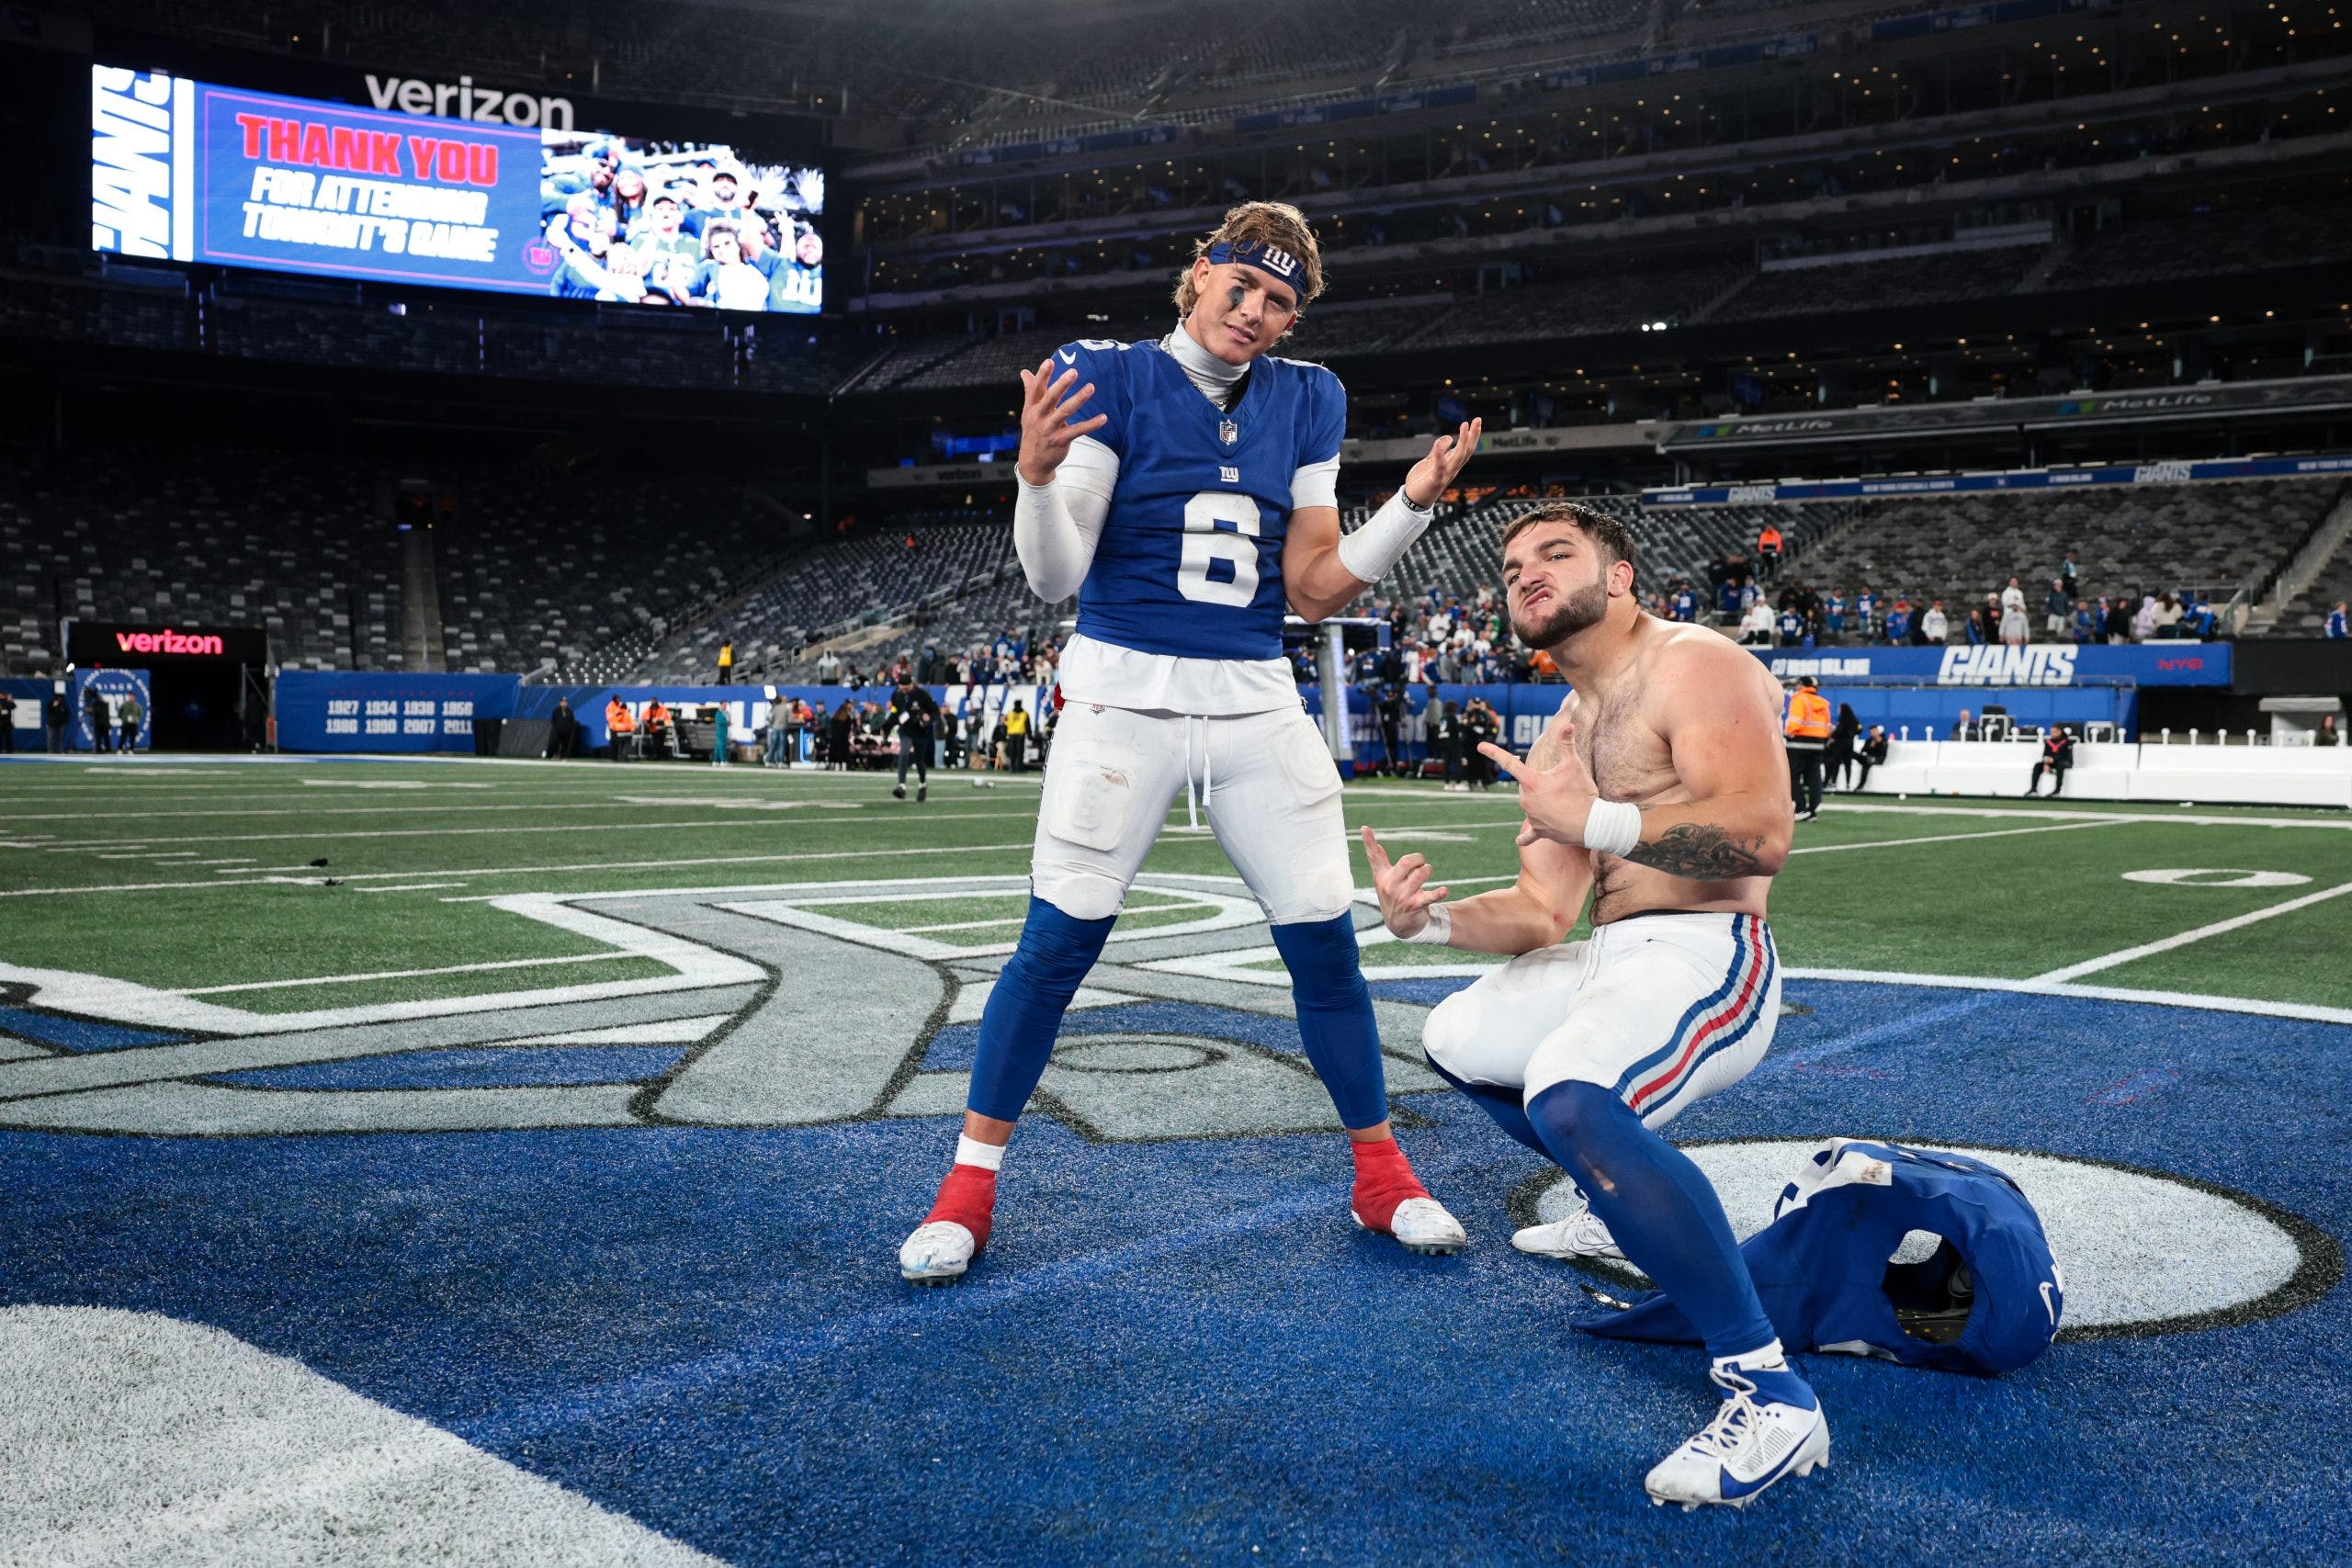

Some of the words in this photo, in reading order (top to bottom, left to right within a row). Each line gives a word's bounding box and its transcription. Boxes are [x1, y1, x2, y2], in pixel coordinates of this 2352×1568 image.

[365, 74, 574, 131] verizon
[235, 112, 402, 176] THANK
[407, 136, 499, 187] YOU
[249, 165, 317, 208] FOR
[313, 175, 489, 226] ATTENDING
[407, 220, 499, 263] GAME
[2102, 394, 2212, 411] MetLife
[1736, 420, 1834, 434] MetLife
[2133, 463, 2193, 482] GIANTS
[1178, 491, 1261, 608] 6
[116, 629, 223, 655] verizon
[1937, 644, 2079, 685] GIANTS
[403, 718, 436, 734] 2007
